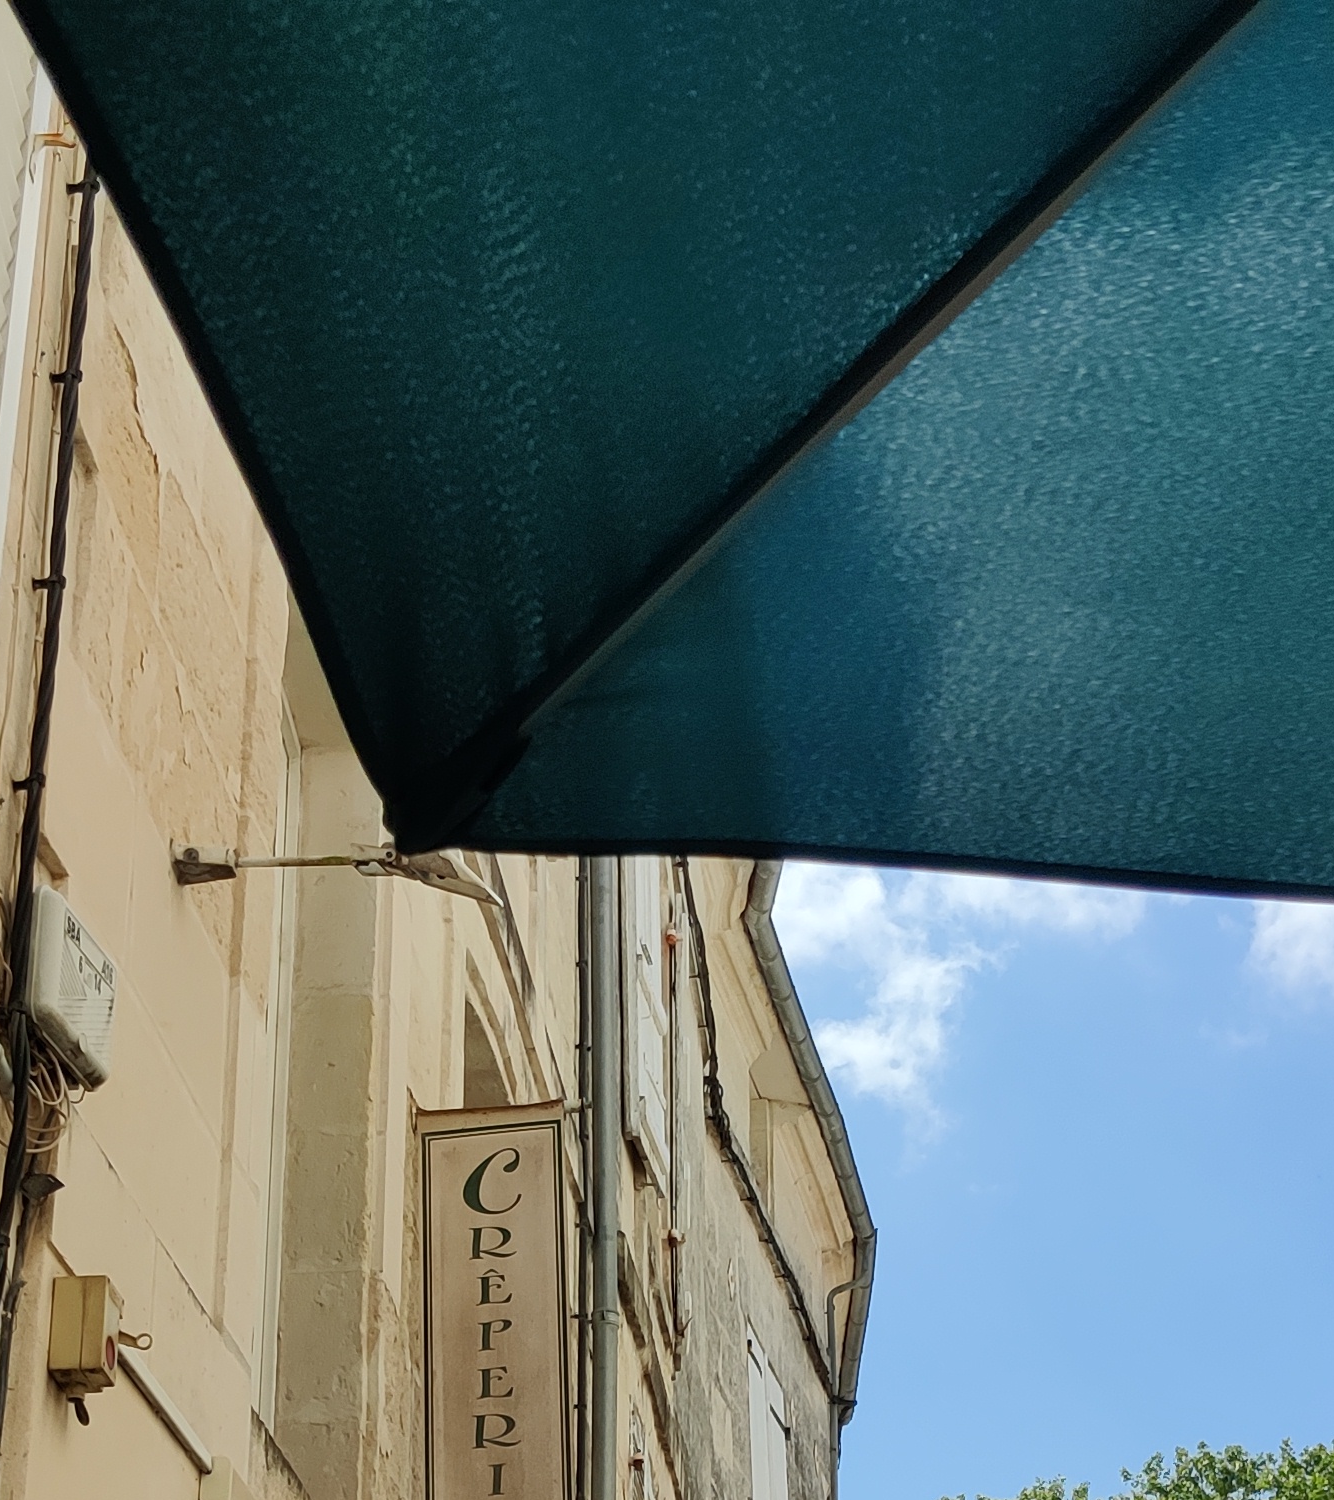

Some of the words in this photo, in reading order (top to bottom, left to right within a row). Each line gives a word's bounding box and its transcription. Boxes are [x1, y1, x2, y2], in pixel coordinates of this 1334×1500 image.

[67, 915, 81, 947] SBA
[78, 955, 83, 974] 6
[94, 973, 102, 996] 14
